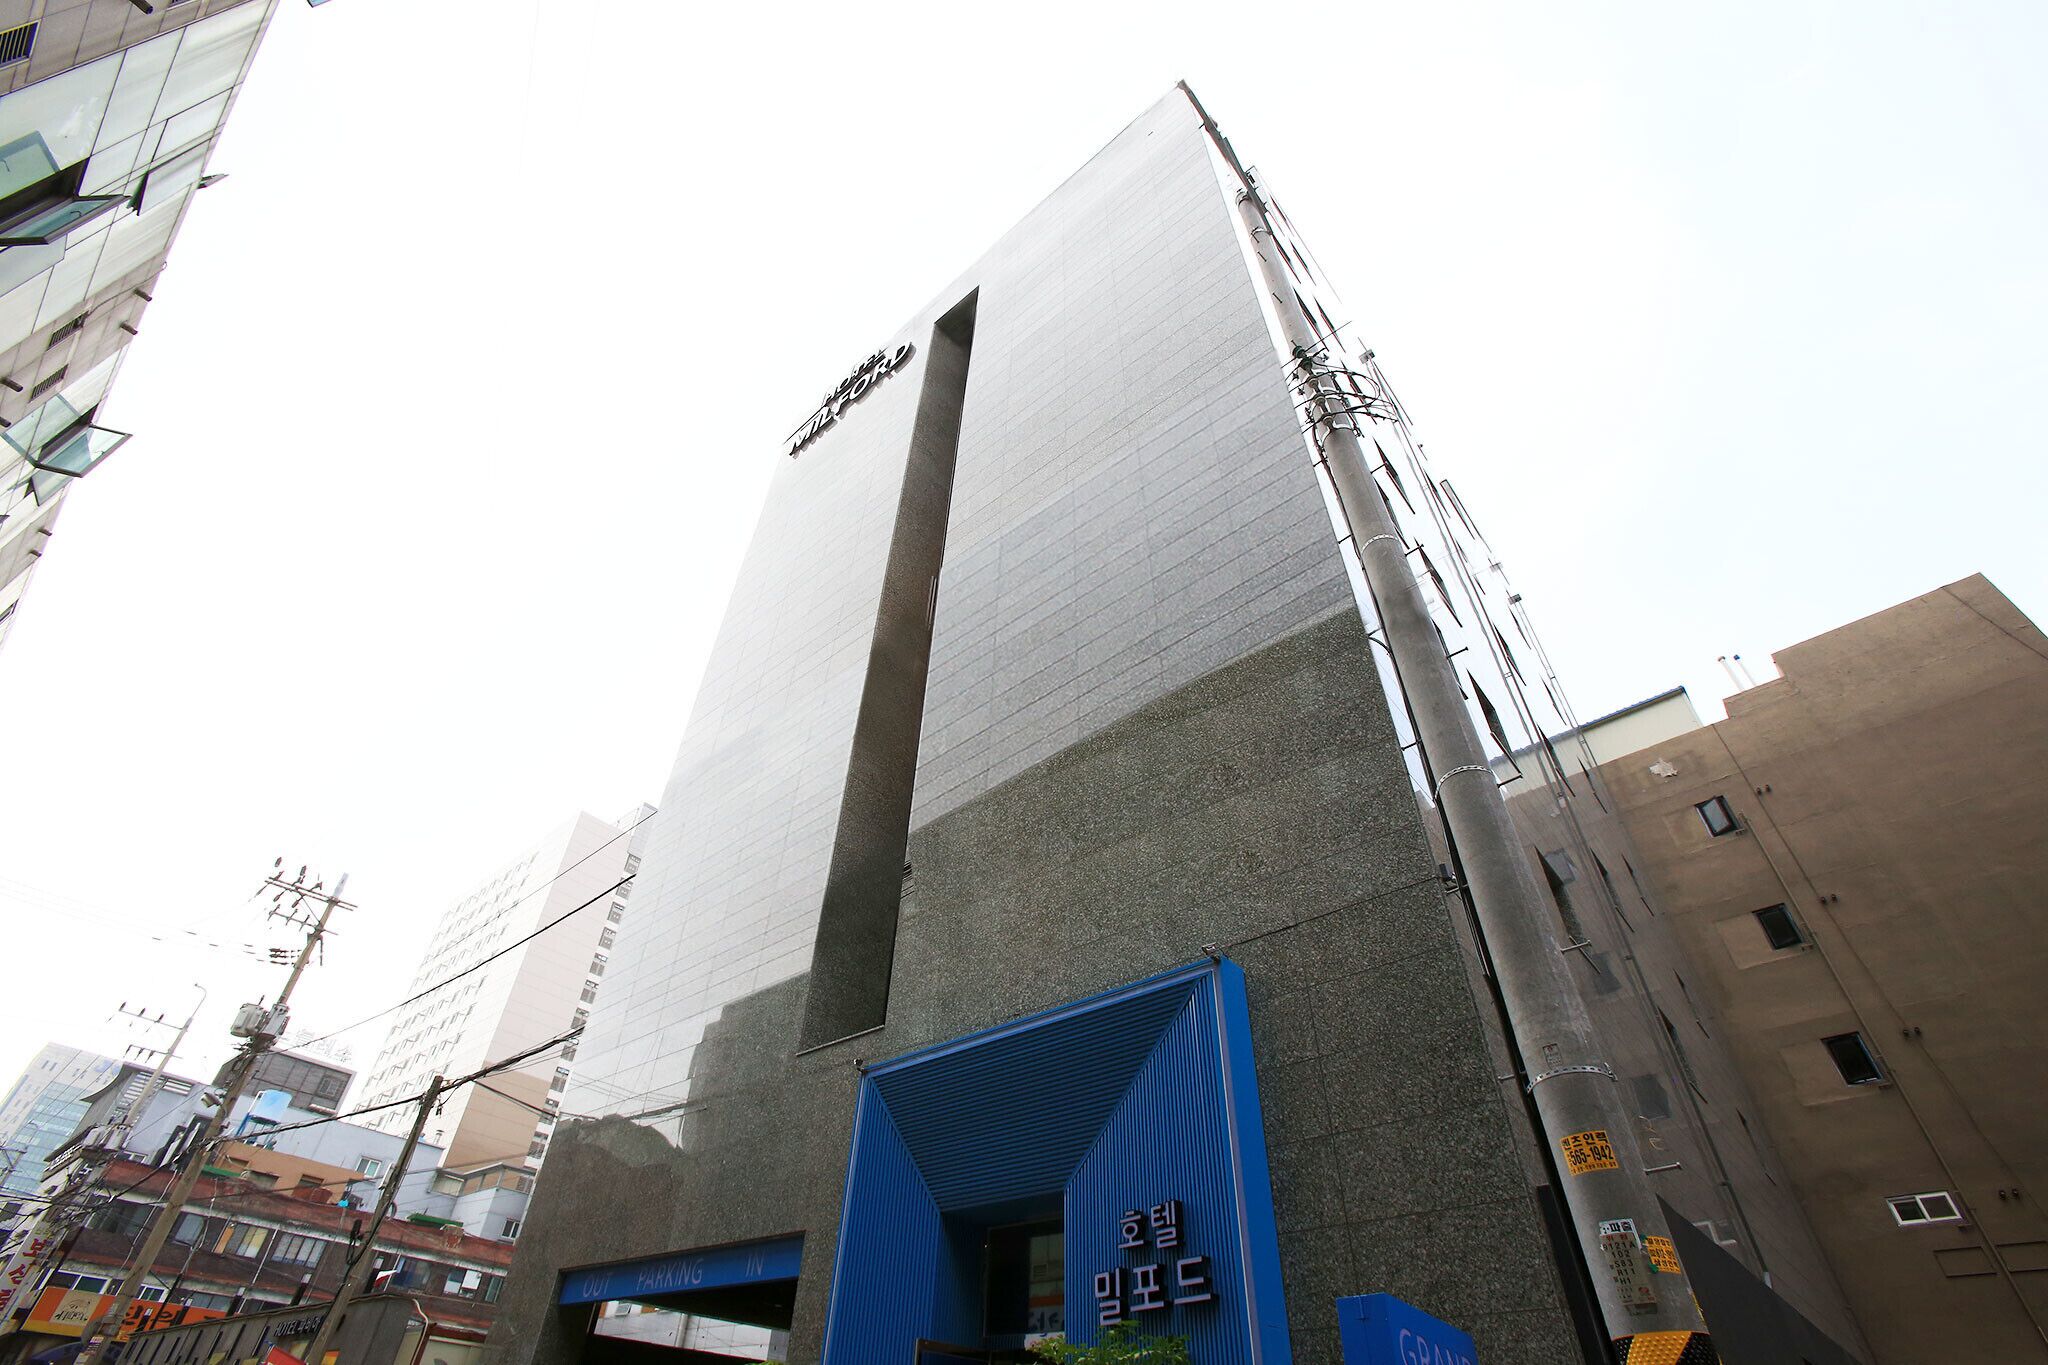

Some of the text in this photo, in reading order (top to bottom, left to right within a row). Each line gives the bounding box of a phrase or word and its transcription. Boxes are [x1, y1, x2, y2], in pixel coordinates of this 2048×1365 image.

[788, 342, 916, 459] MILFORD
[1570, 1145, 1614, 1166] 565-1942
[1118, 1200, 1182, 1249] 호텔
[582, 1248, 766, 1299] OUT PARKING IN
[1611, 1249, 1631, 1259] 102
[1094, 1256, 1214, 1326] 밀포드
